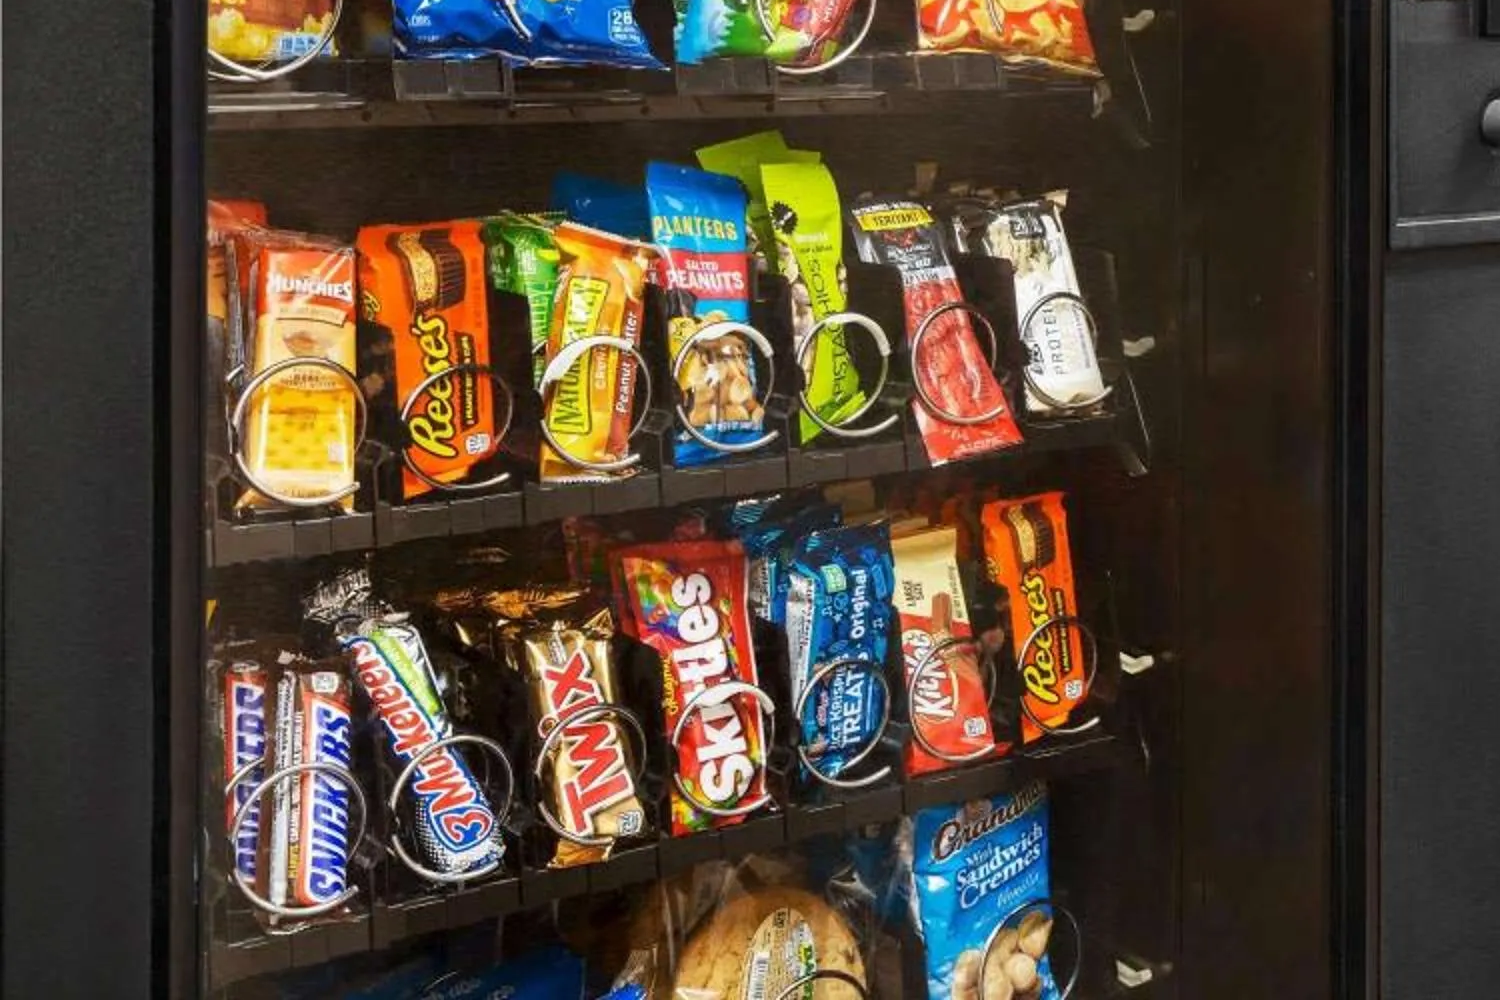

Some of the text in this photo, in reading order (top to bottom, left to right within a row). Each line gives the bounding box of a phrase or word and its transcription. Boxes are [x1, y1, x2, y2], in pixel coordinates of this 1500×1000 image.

[612, 9, 638, 27] 28
[652, 215, 738, 241] PLANTERS
[666, 269, 745, 290] PEANUTS
[408, 314, 457, 458] Reese's
[849, 568, 868, 641] Original
[1022, 572, 1060, 704] Reese's
[308, 705, 351, 905] SNICKRS
[440, 806, 494, 845] 3
[956, 822, 1044, 885] Sandwich
[959, 843, 1042, 910] Cremes
